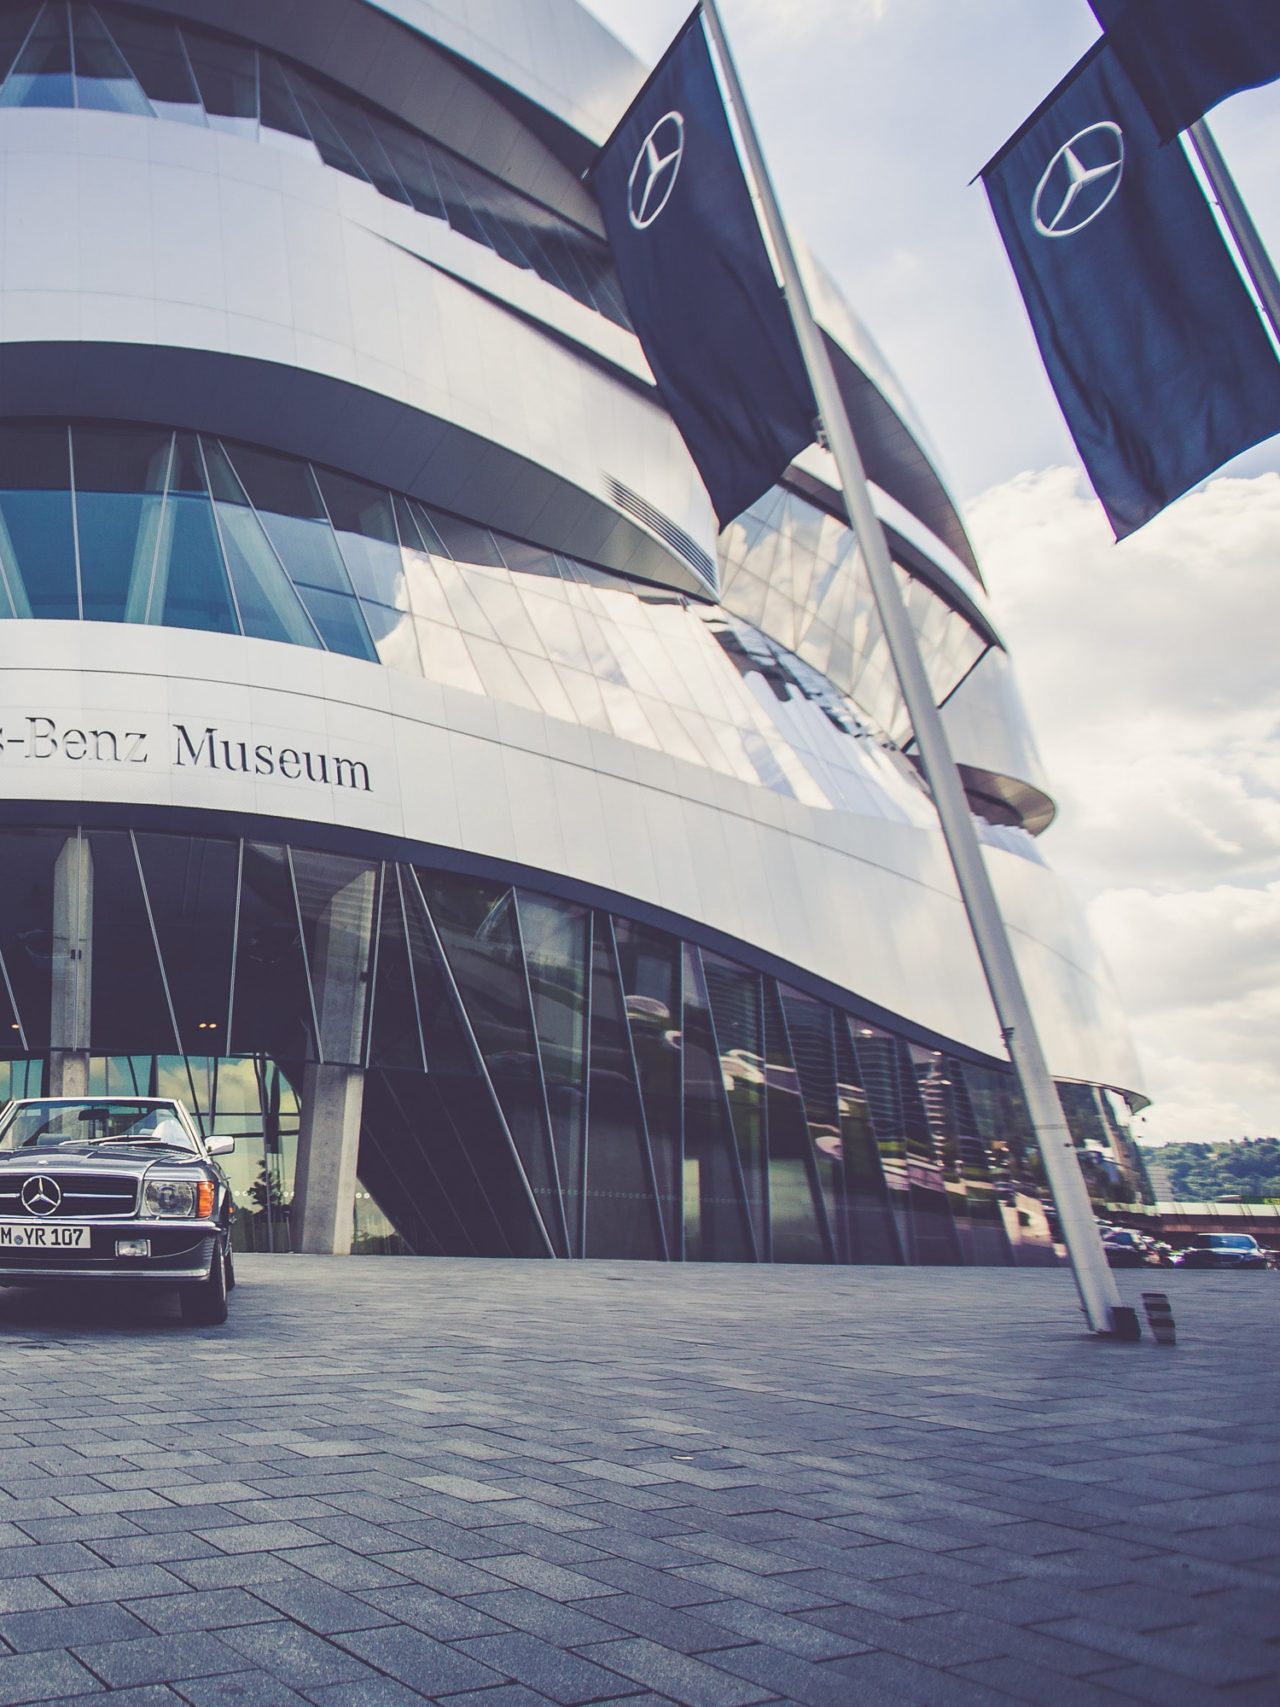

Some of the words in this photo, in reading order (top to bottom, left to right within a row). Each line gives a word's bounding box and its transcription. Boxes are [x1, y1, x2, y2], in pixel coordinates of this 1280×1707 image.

[172, 724, 373, 792] Museum
[1, 1227, 12, 1244] M
[24, 1227, 46, 1245] YR
[51, 1228, 83, 1246] 107
